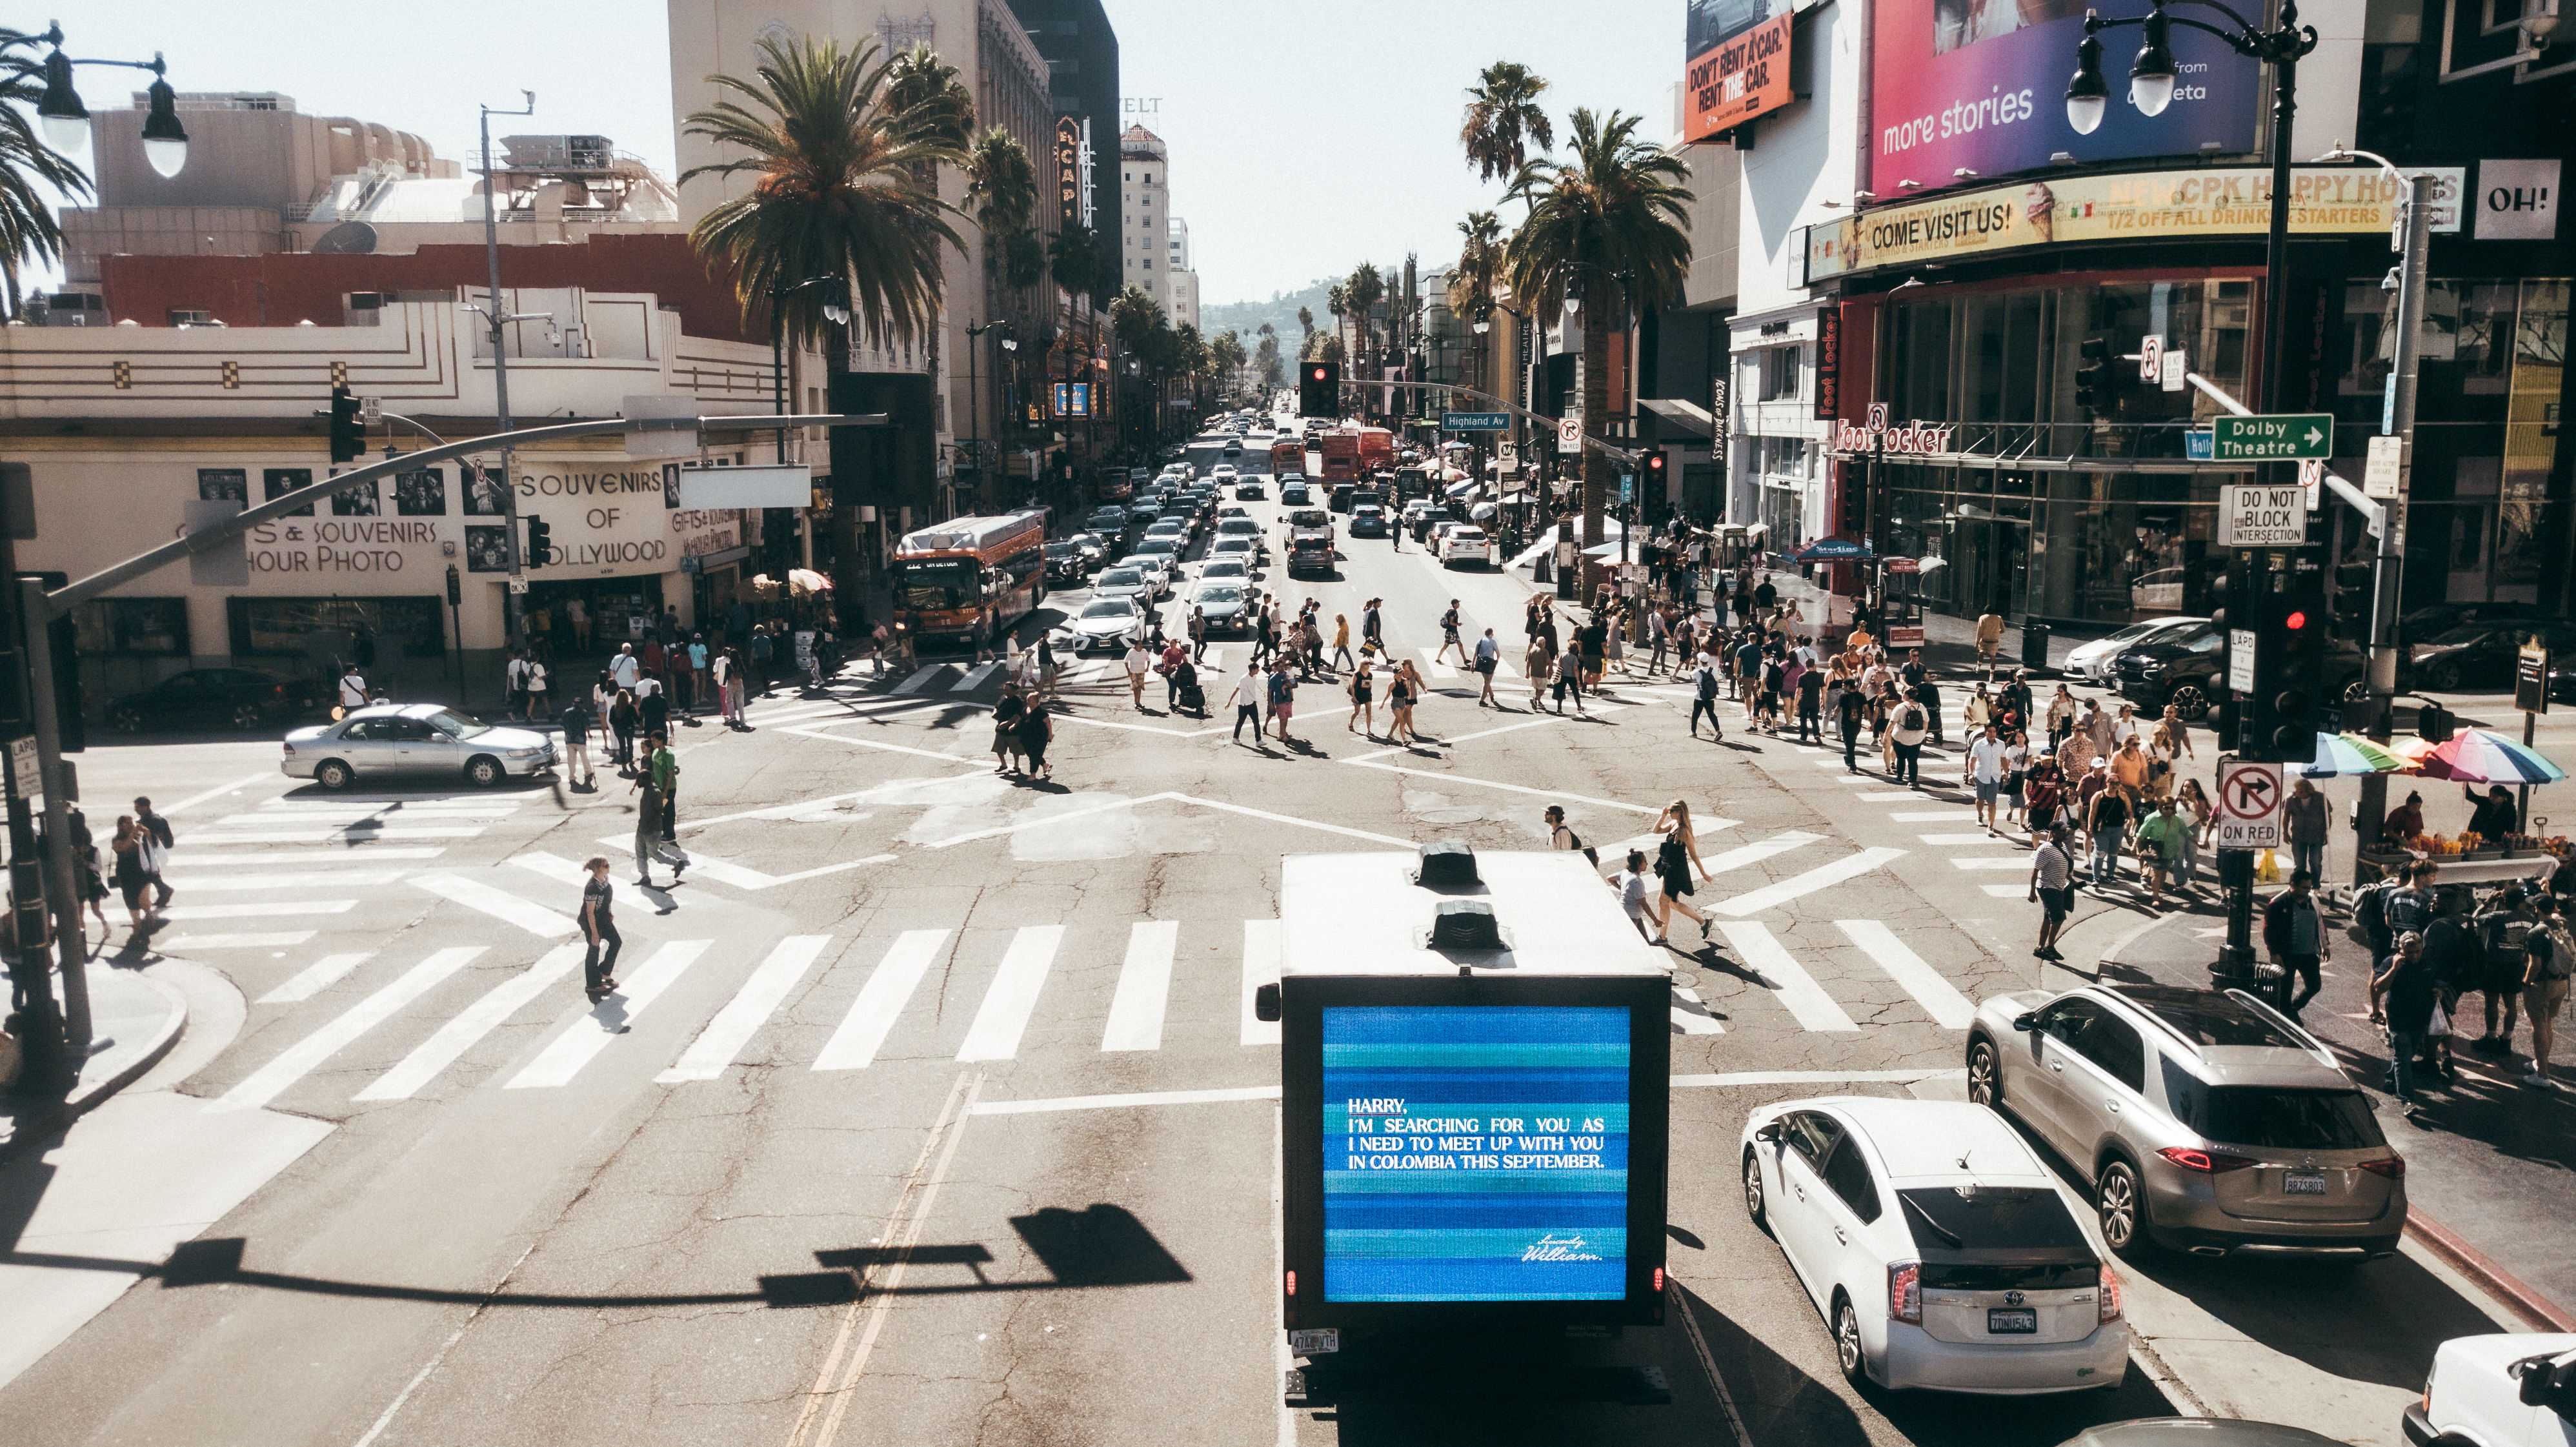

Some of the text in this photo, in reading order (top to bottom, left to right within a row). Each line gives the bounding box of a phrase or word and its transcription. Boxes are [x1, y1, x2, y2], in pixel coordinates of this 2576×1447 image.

[1691, 28, 1782, 92] DON'T RENT A CAR.
[1699, 61, 1769, 114] RENT THE CAR.
[2170, 85, 2206, 100] eta
[1120, 97, 1163, 113] ELT
[1884, 85, 2032, 155] more stories
[1060, 131, 1076, 145] EL
[2180, 176, 2244, 204] CPK
[2489, 187, 2547, 212] OH!
[2138, 211, 2173, 227] OFF
[2174, 209, 2207, 225] ALL
[2212, 208, 2272, 225] DRINK
[2297, 208, 2380, 224] STARTERS
[1873, 219, 1919, 250] COME
[1925, 210, 1971, 241] VISIT
[1978, 204, 2011, 233] US!
[1715, 379, 1726, 409] ICONS
[1449, 417, 1488, 427] Highland
[2233, 421, 2286, 438] Dolby
[1712, 416, 1725, 461] DARKNESS
[1882, 420, 1950, 454] ocker
[2222, 441, 2296, 455] Theatre
[521, 472, 661, 496] SOUVENIRS
[2242, 491, 2297, 507] DO NOT
[587, 508, 619, 529] OF
[672, 510, 702, 532] GIFTS
[2245, 511, 2291, 527] BLOCK
[286, 526, 305, 541] &
[314, 522, 436, 543] SOUVENIRS
[2233, 530, 2301, 541] INTERSECTION
[318, 546, 403, 572] PHOTO
[2232, 634, 2253, 647] LAPD
[2224, 826, 2275, 839] ON RED
[1348, 1098, 1407, 1115] HARRY,
[1348, 1118, 1604, 1133] I'M SEARCHING FOR YOU AS
[1349, 1137, 1604, 1151] I NEED TO MEET UP WITH YOU
[1349, 1155, 1605, 1169] IN COLOMBIA THIS SEPTEMBER.
[1522, 1244, 1602, 1261] William.
[1991, 1318, 2033, 1330] 7DNU543
[1294, 1335, 1336, 1349] 47A VTH
